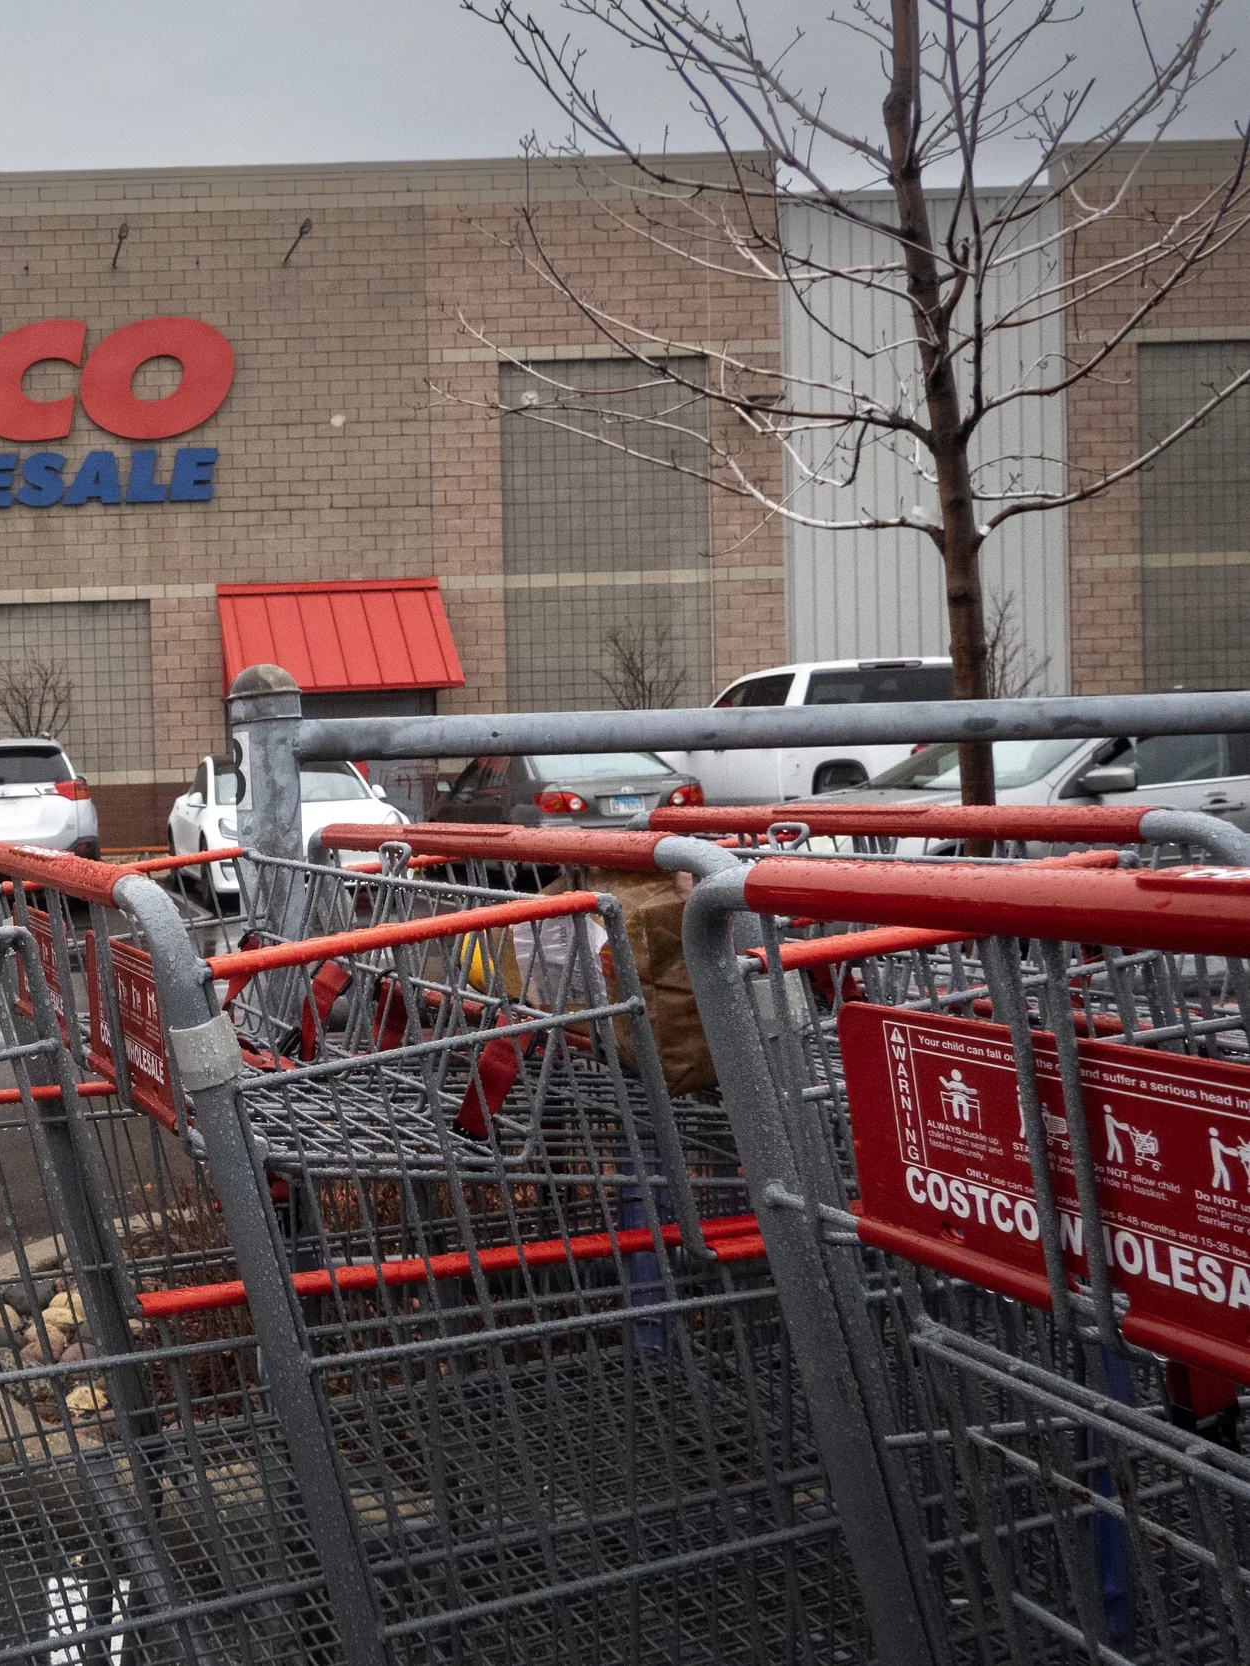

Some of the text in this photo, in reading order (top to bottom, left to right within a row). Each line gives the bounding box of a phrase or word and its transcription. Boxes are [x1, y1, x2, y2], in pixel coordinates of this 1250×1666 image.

[918, 1035, 940, 1048] Your
[941, 1040, 965, 1053] child
[967, 1046, 984, 1057] can
[986, 1048, 1001, 1060] fall
[1004, 1053, 1016, 1063] ou
[1036, 1058, 1053, 1070] the
[1079, 1068, 1100, 1080] and
[1102, 1072, 1137, 1087] suffer
[1139, 1080, 1147, 1090] a
[1150, 1082, 1197, 1099] serious
[1200, 1090, 1232, 1106] head
[891, 1044, 920, 1161] WARNING
[927, 1119, 999, 1146] ALWAYS buckle up
[927, 1129, 944, 1141] child
[954, 1137, 969, 1146] cart
[970, 1141, 987, 1151] seat
[988, 1146, 1004, 1156] and
[928, 1138, 951, 1151] fasten
[1012, 1141, 1030, 1153] STA
[1103, 1177, 1120, 1188] ride
[1123, 1181, 1131, 1192] in
[1133, 1183, 1168, 1201] basket.
[1106, 1166, 1128, 1180] NOT
[1131, 1174, 1156, 1187] allow
[1158, 1180, 1181, 1193] child
[905, 1166, 1040, 1242] COSTCO
[966, 1167, 990, 1182] ONLY
[991, 1176, 1006, 1187] use
[1007, 1181, 1023, 1191] cart
[1117, 1211, 1139, 1226] 6-48
[1140, 1220, 1176, 1237] months
[1178, 1230, 1198, 1243] and
[1201, 1236, 1229, 1252] 15-35
[1195, 1189, 1210, 1201] Do
[1213, 1194, 1239, 1209] NOT
[1196, 1202, 1218, 1215] own
[1197, 1214, 1231, 1231] carrier
[1233, 1224, 1244, 1234] or
